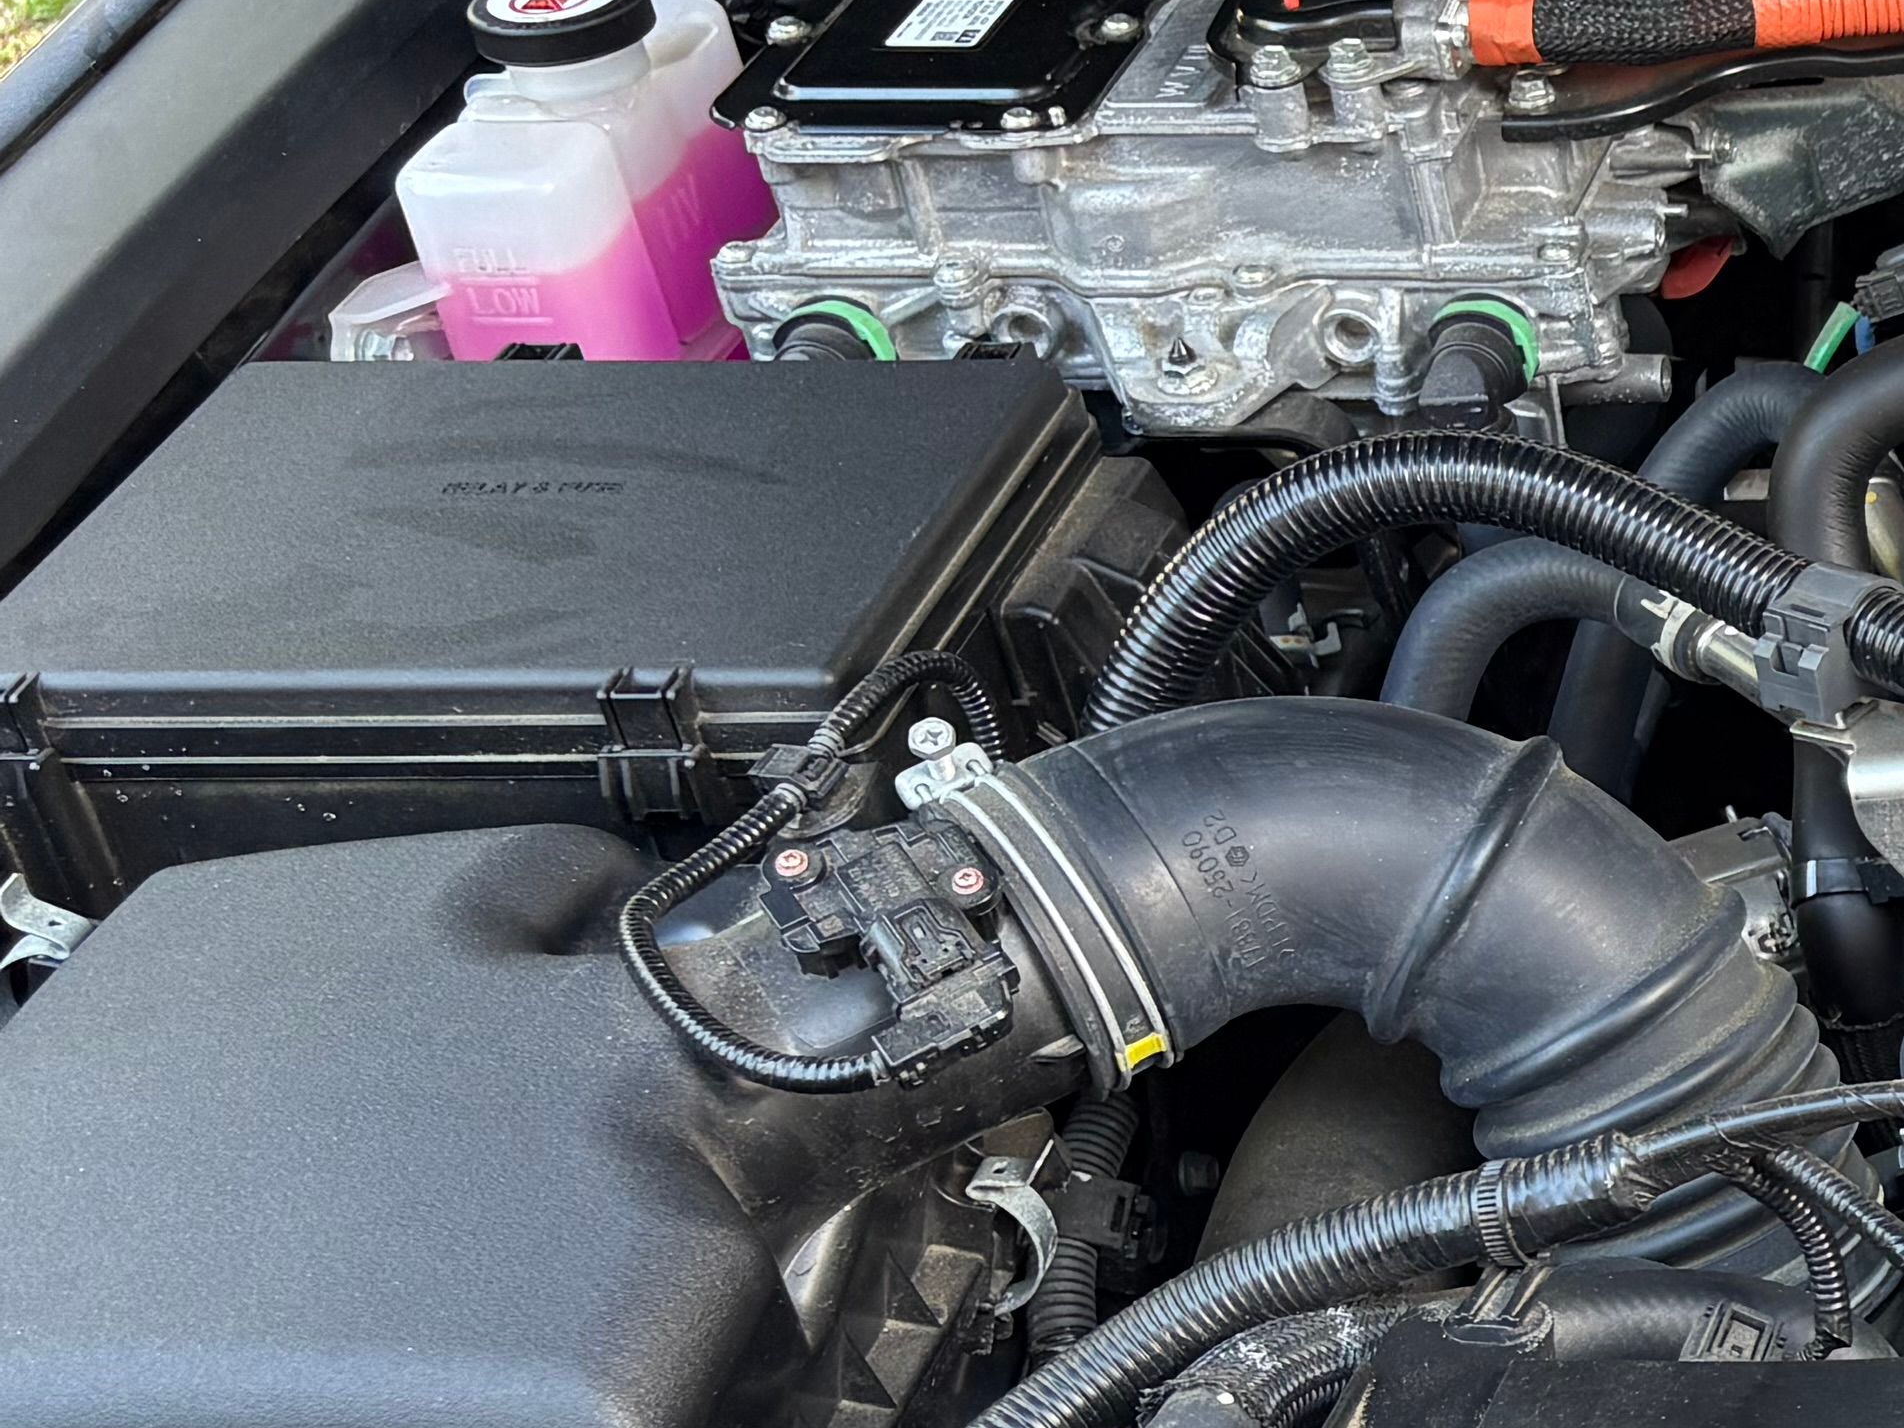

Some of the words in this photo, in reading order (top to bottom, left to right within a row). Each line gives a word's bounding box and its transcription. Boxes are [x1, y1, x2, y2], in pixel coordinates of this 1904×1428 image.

[453, 246, 527, 273] FULL
[466, 285, 541, 316] LOW
[442, 481, 528, 496] RELAY
[558, 481, 625, 496] FUSE
[1203, 809, 1237, 845] D2
